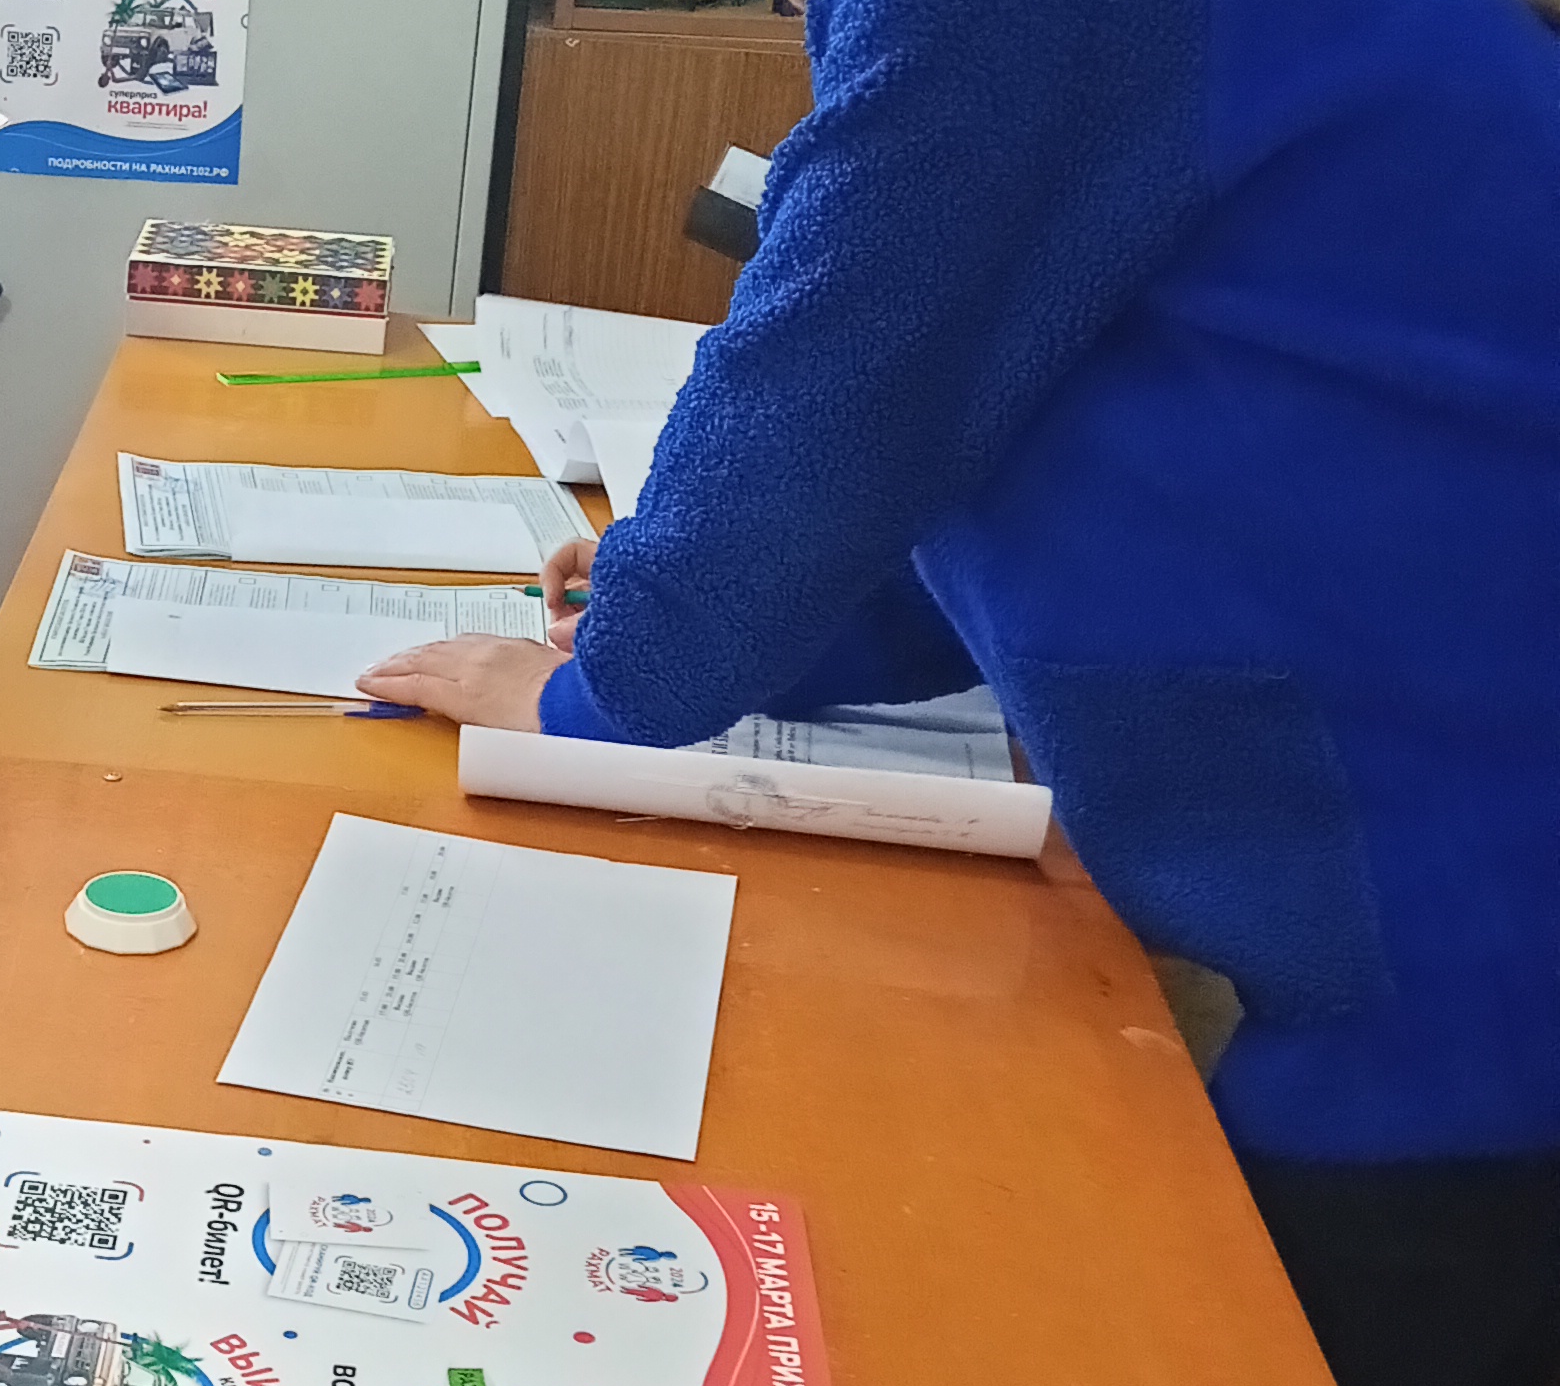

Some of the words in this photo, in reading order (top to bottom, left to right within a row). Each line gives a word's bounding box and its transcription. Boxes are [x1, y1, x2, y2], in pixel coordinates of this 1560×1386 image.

[107, 99, 208, 122] квартира!
[109, 90, 158, 101] суперприз
[47, 157, 129, 172] ПОДРОБНОСТИ
[132, 160, 147, 172] НА
[308, 1195, 332, 1227] РАХМАТ
[197, 1181, 245, 1287] QR-билет!
[446, 1192, 526, 1331] ПОЛУЧАЙ
[584, 1247, 612, 1292] РАХМАТ
[668, 1266, 684, 1288] 2024
[754, 1257, 794, 1328] МАРТА
